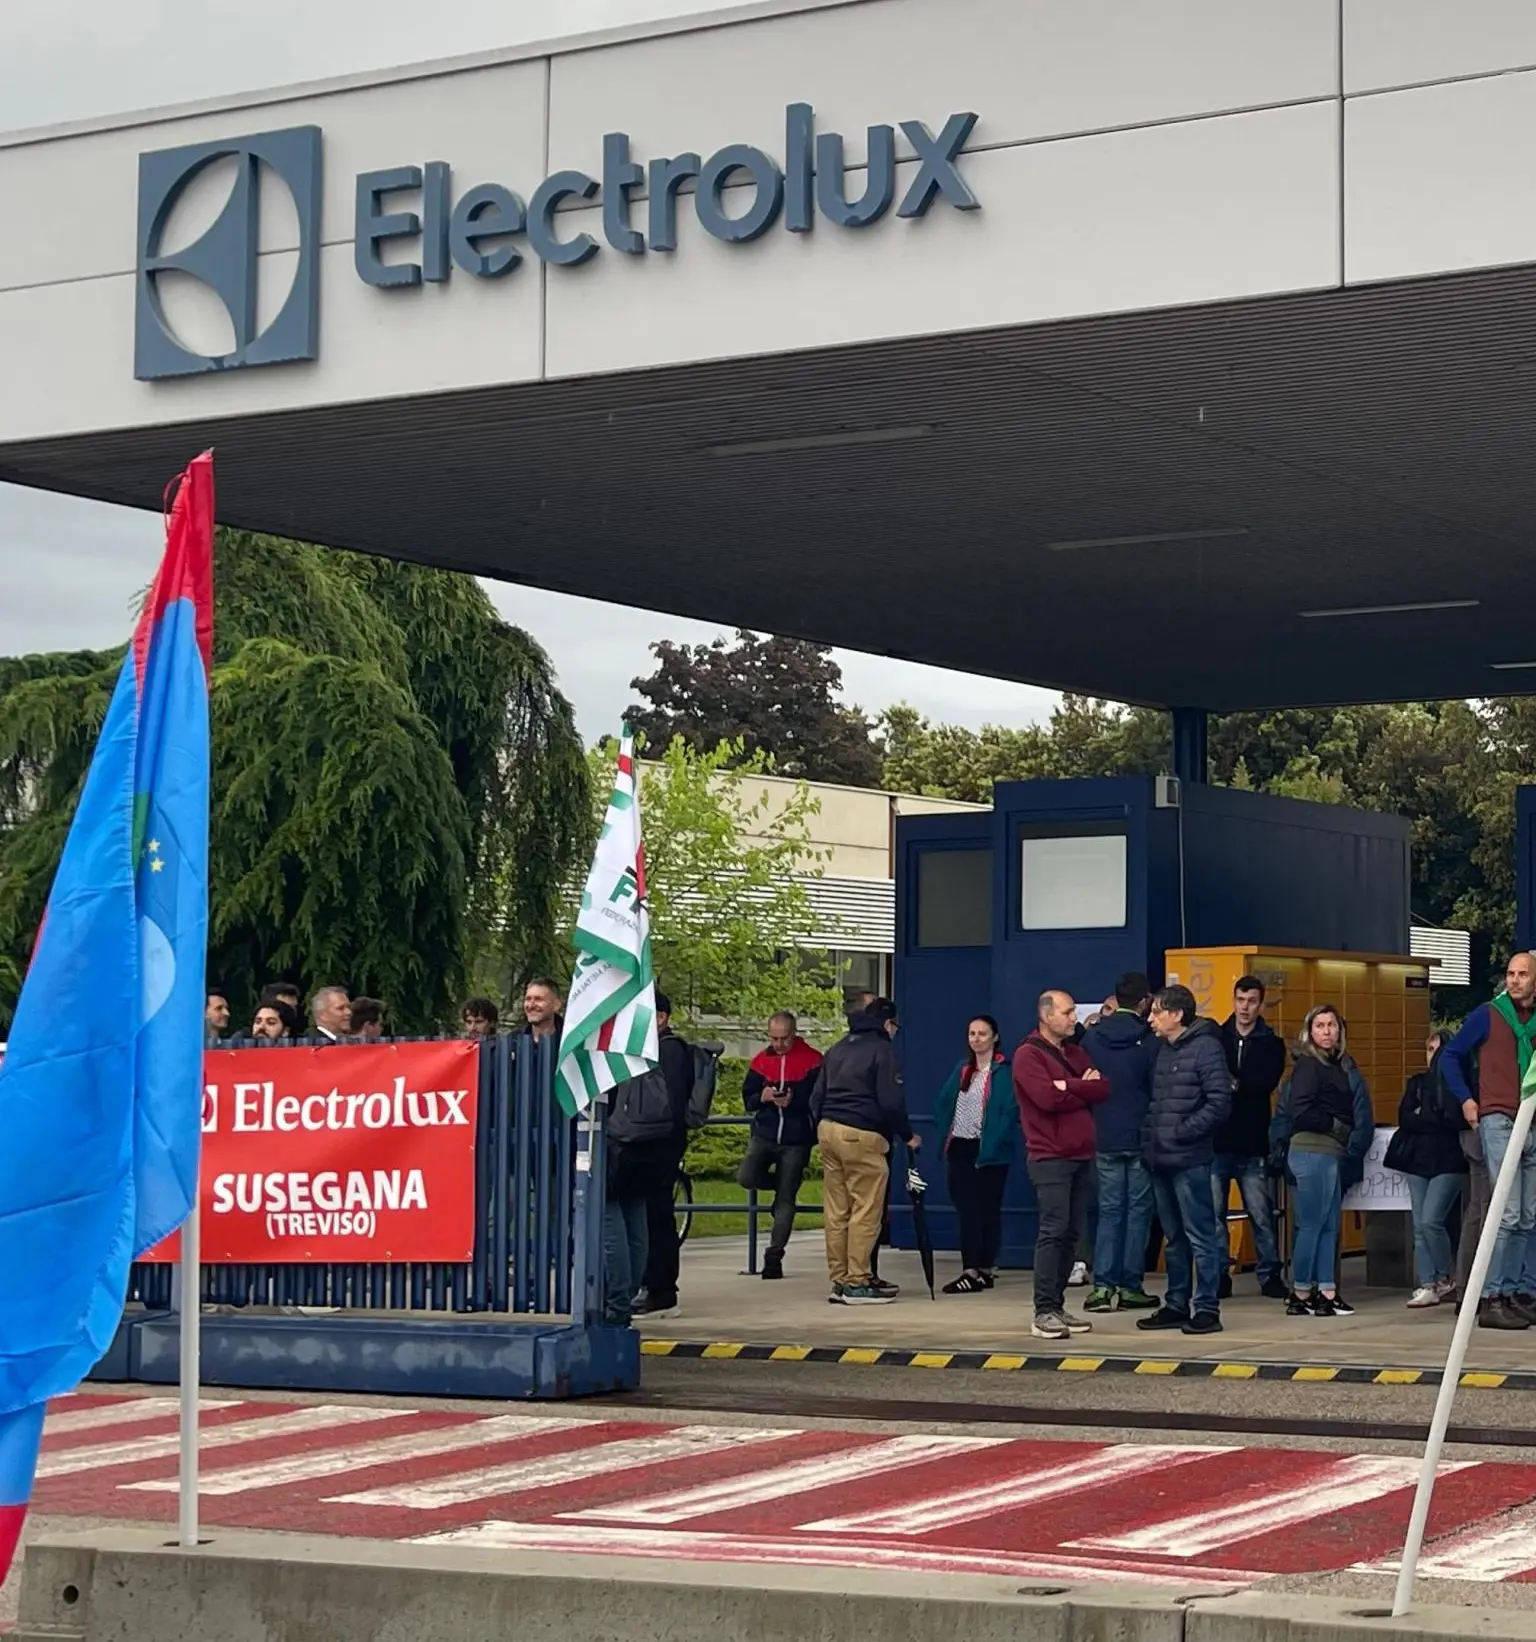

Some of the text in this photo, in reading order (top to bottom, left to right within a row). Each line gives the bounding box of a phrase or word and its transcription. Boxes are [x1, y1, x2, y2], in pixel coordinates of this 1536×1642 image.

[354, 102, 981, 287] Electrolux
[232, 1076, 470, 1132] Electrolux
[212, 1169, 428, 1213] SUSEGANA
[266, 1211, 376, 1239] (TREVISO)
